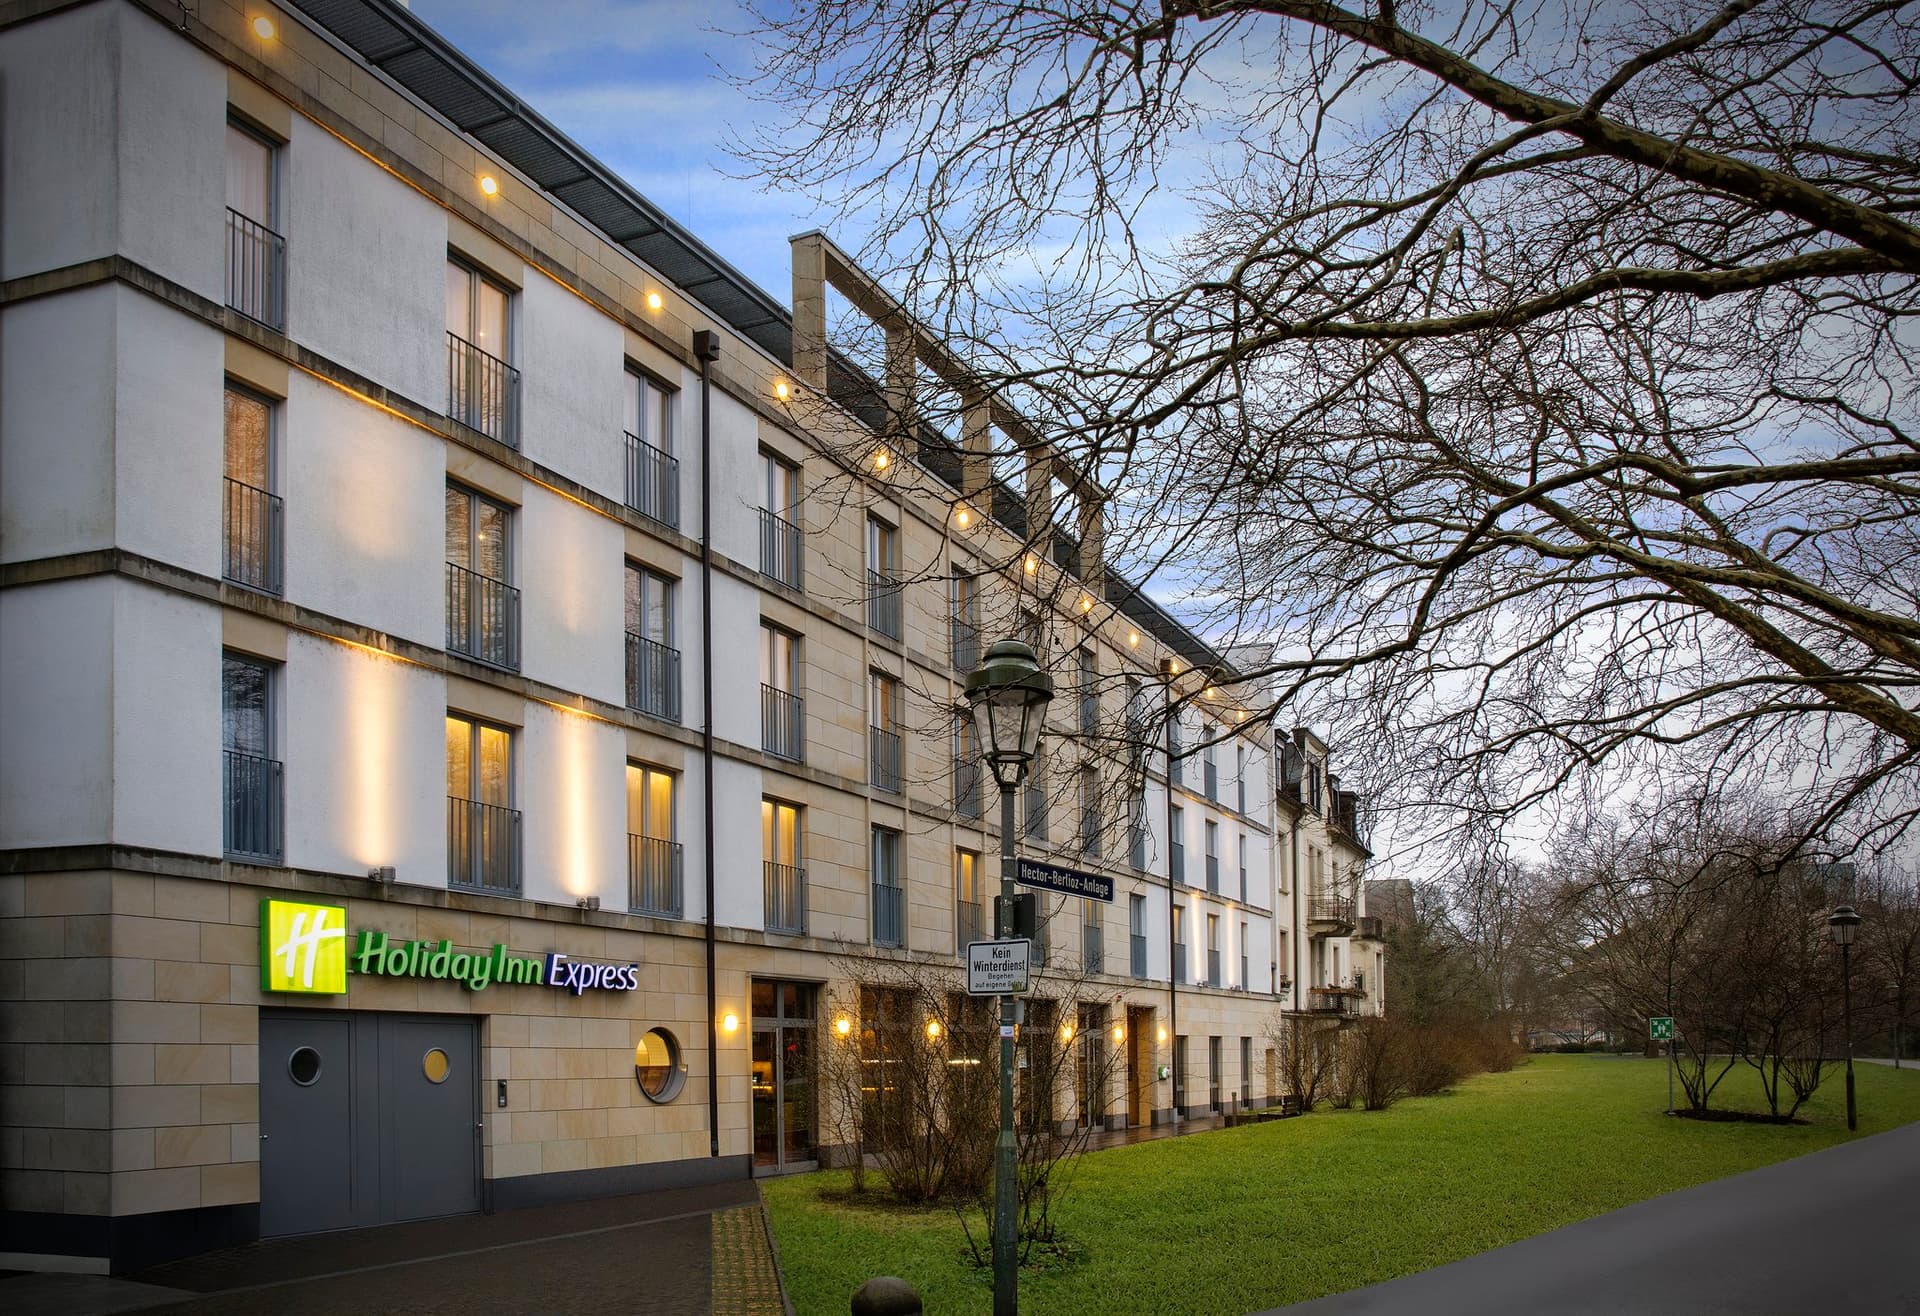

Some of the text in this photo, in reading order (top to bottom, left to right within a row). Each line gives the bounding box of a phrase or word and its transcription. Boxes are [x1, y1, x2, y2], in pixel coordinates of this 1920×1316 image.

[1021, 863, 1109, 897] Hector-Berlioz-Anlage
[353, 931, 639, 996] Holiday Inn Express
[992, 947, 1011, 959] Kein
[973, 959, 1025, 972] Winterdienst
